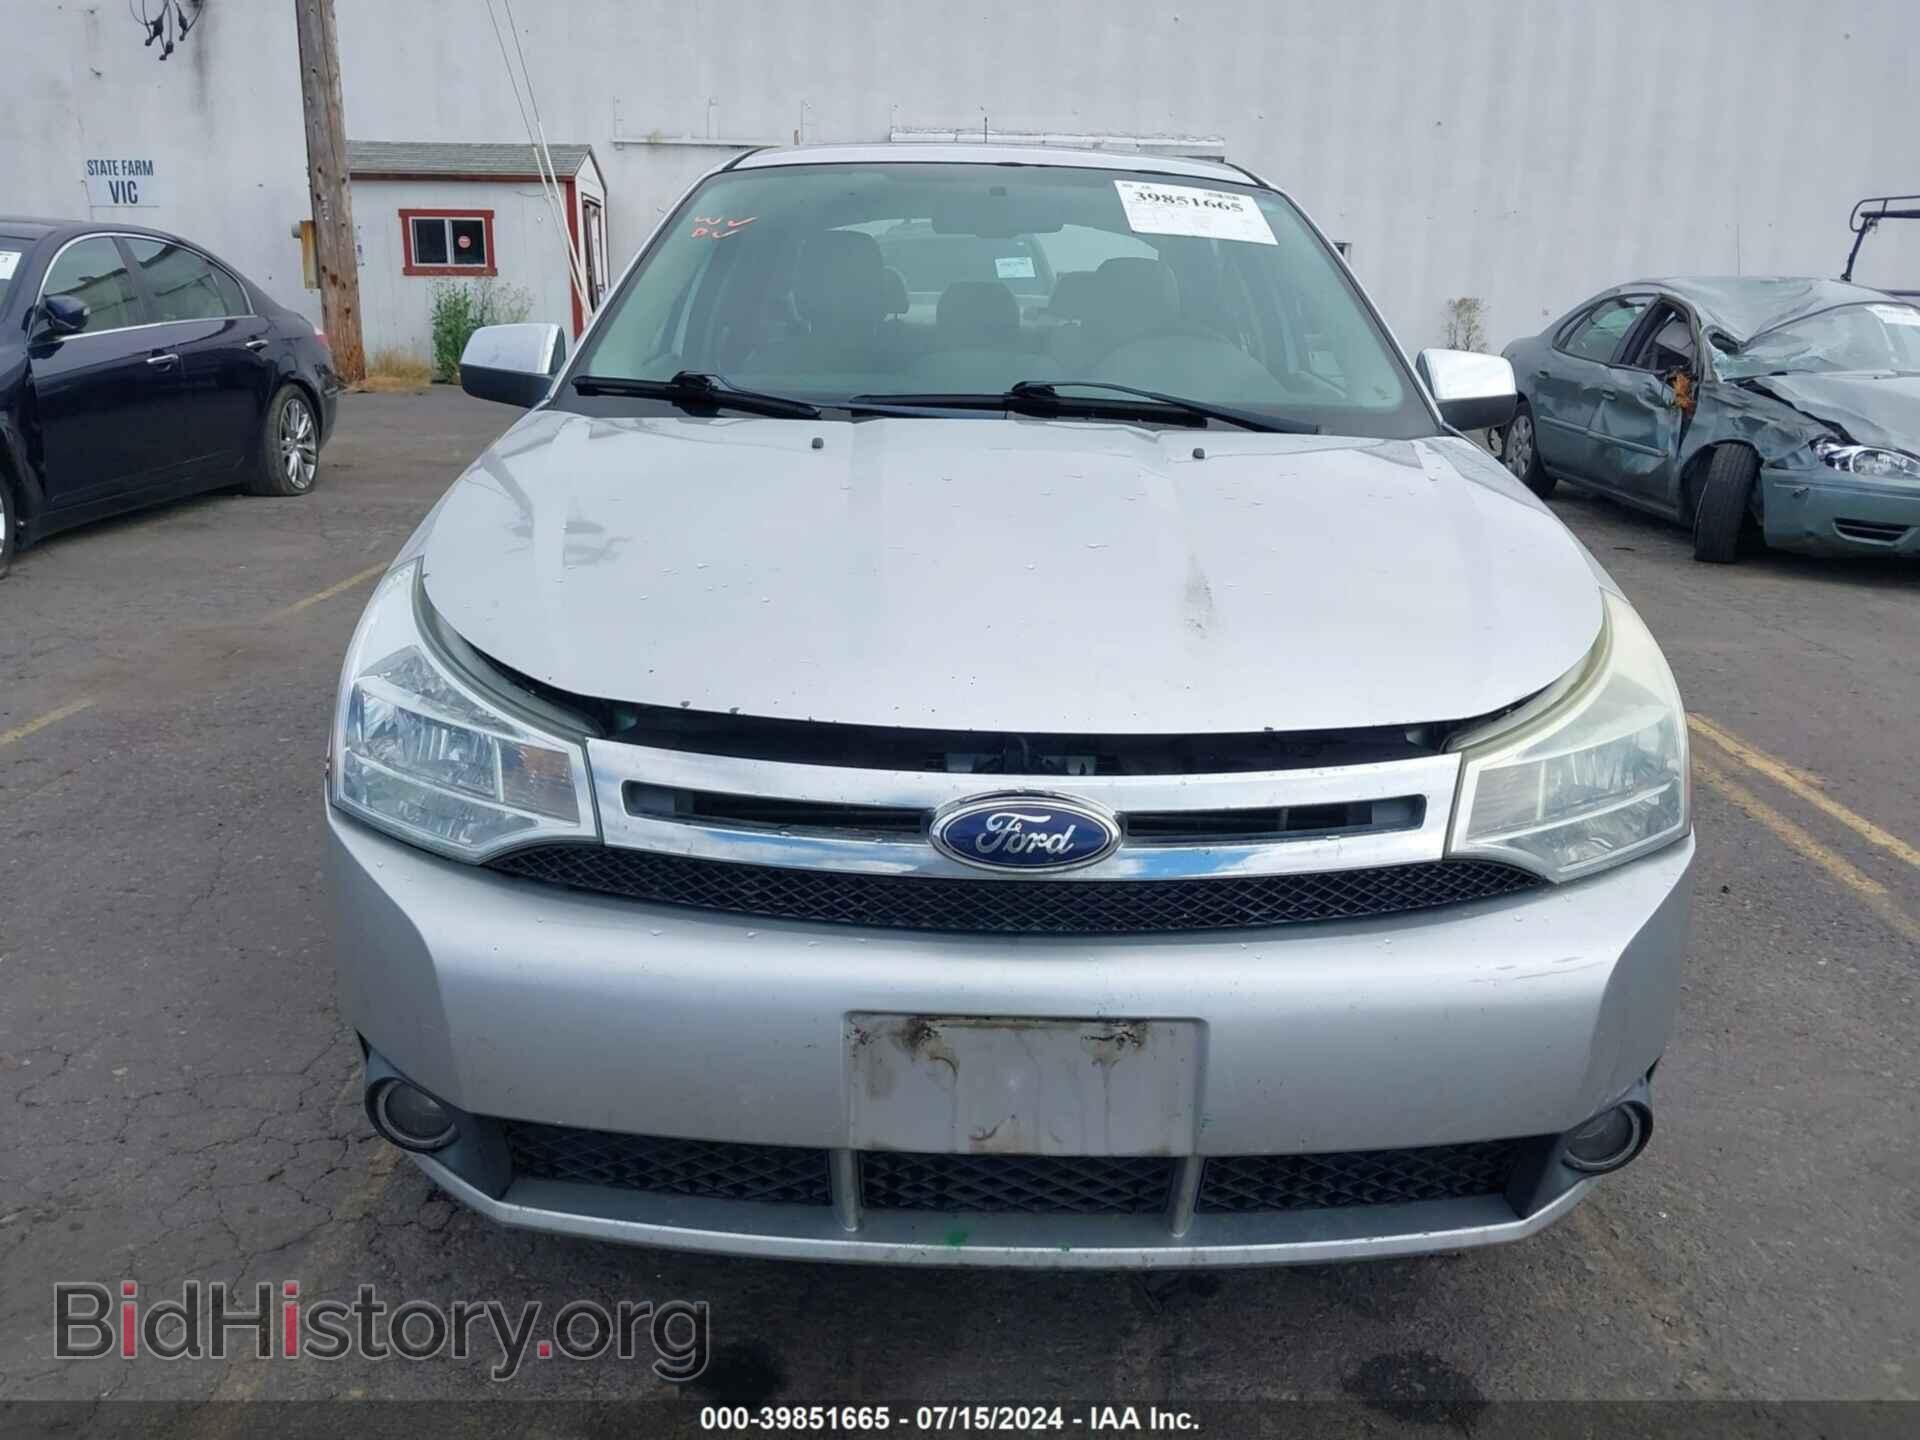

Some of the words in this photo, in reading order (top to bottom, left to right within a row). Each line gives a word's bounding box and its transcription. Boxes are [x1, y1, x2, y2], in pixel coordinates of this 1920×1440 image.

[87, 159, 119, 176] STATE
[121, 159, 153, 176] FARM
[108, 180, 138, 204] VIC
[1134, 191, 1244, 212] 39851665
[975, 812, 1077, 854] Ford
